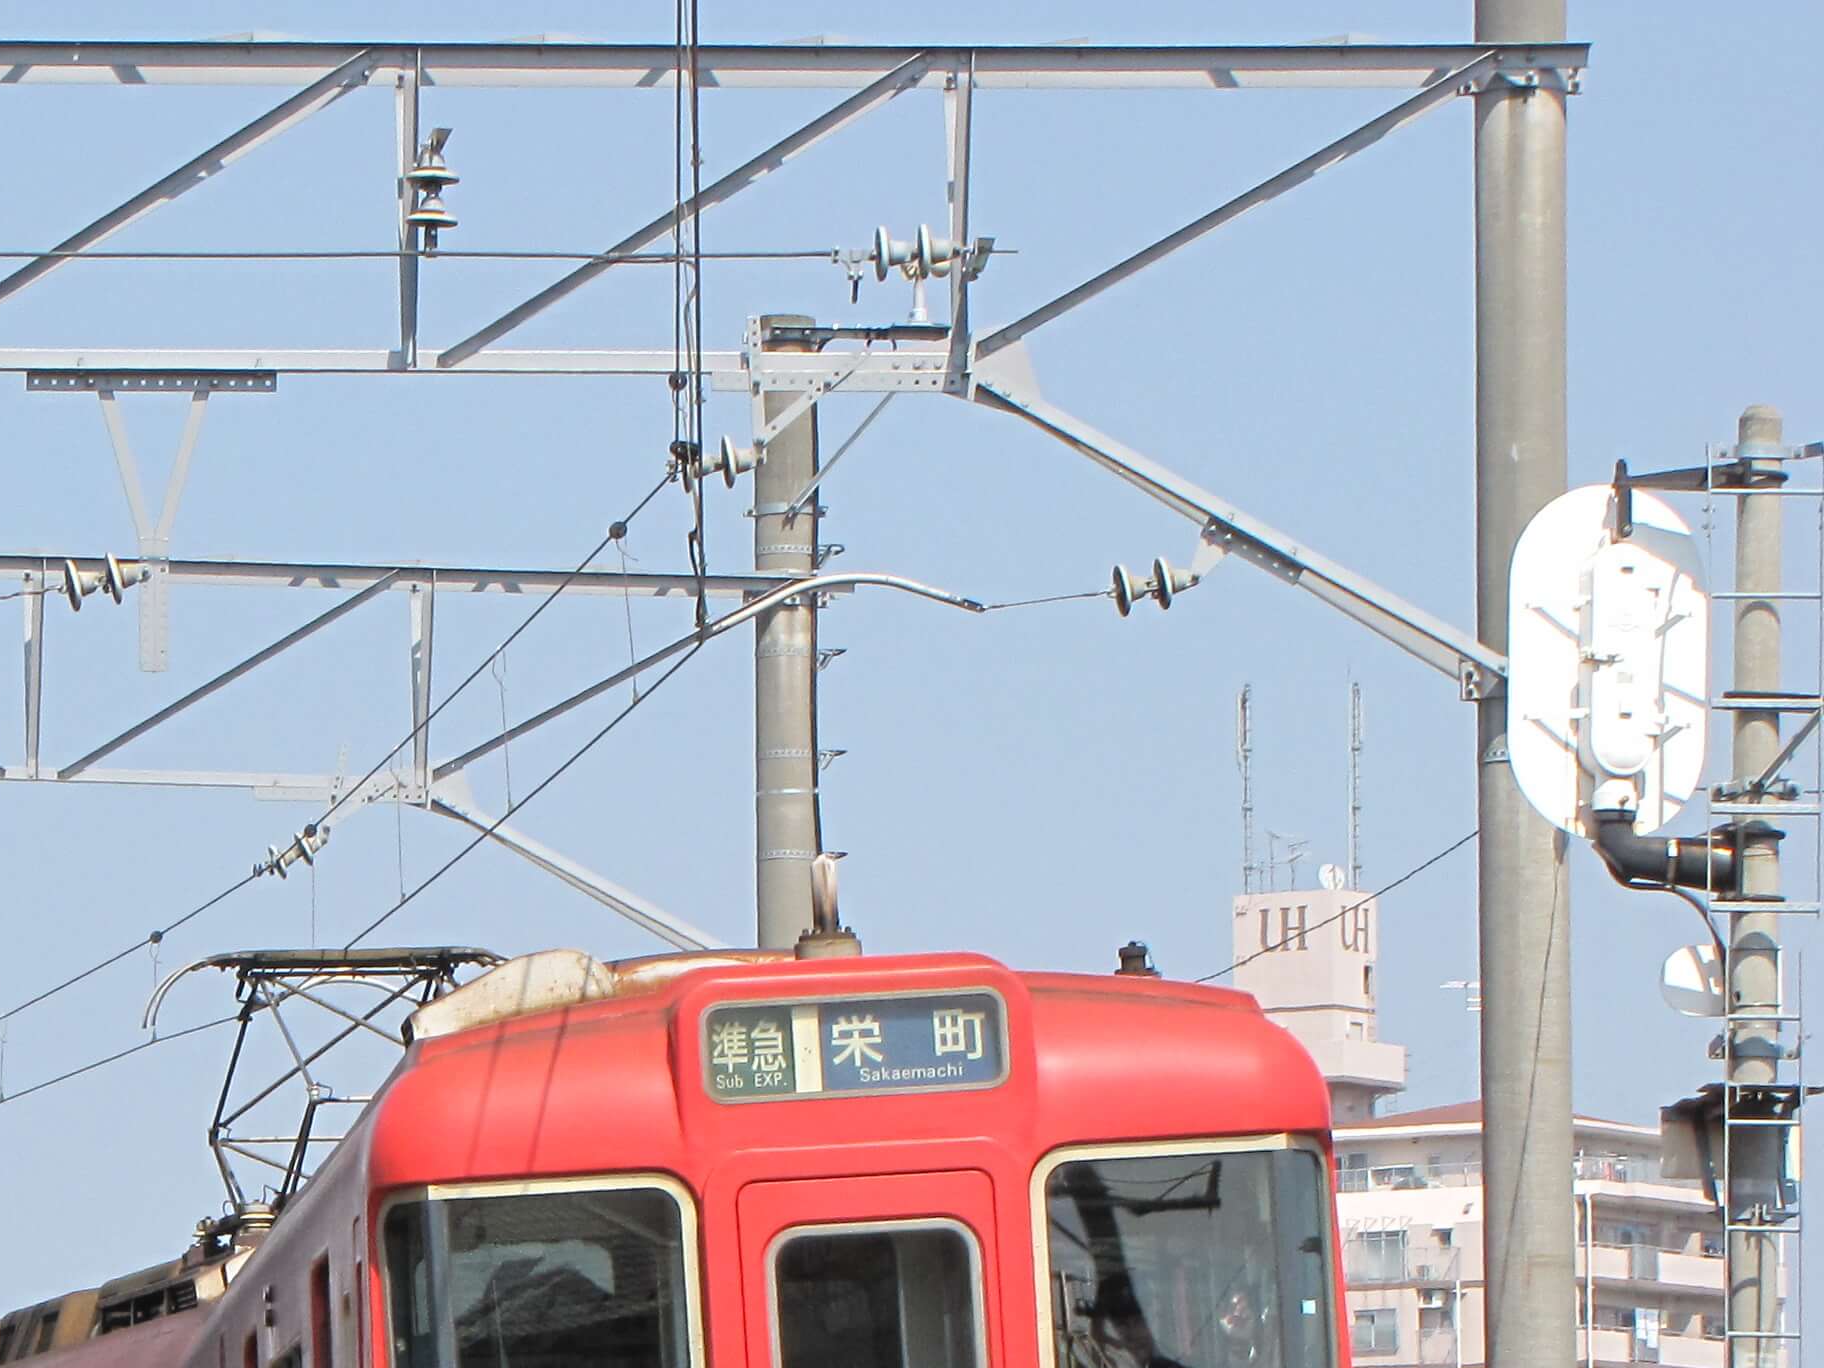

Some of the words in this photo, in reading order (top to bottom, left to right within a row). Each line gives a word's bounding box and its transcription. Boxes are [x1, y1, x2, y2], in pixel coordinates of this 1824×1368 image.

[711, 1019, 788, 1073] 準急
[830, 1008, 986, 1067] 栄町
[715, 1074, 744, 1089] Sub
[754, 1072, 788, 1088] EXP.
[859, 1061, 964, 1083] Sakaemachi
